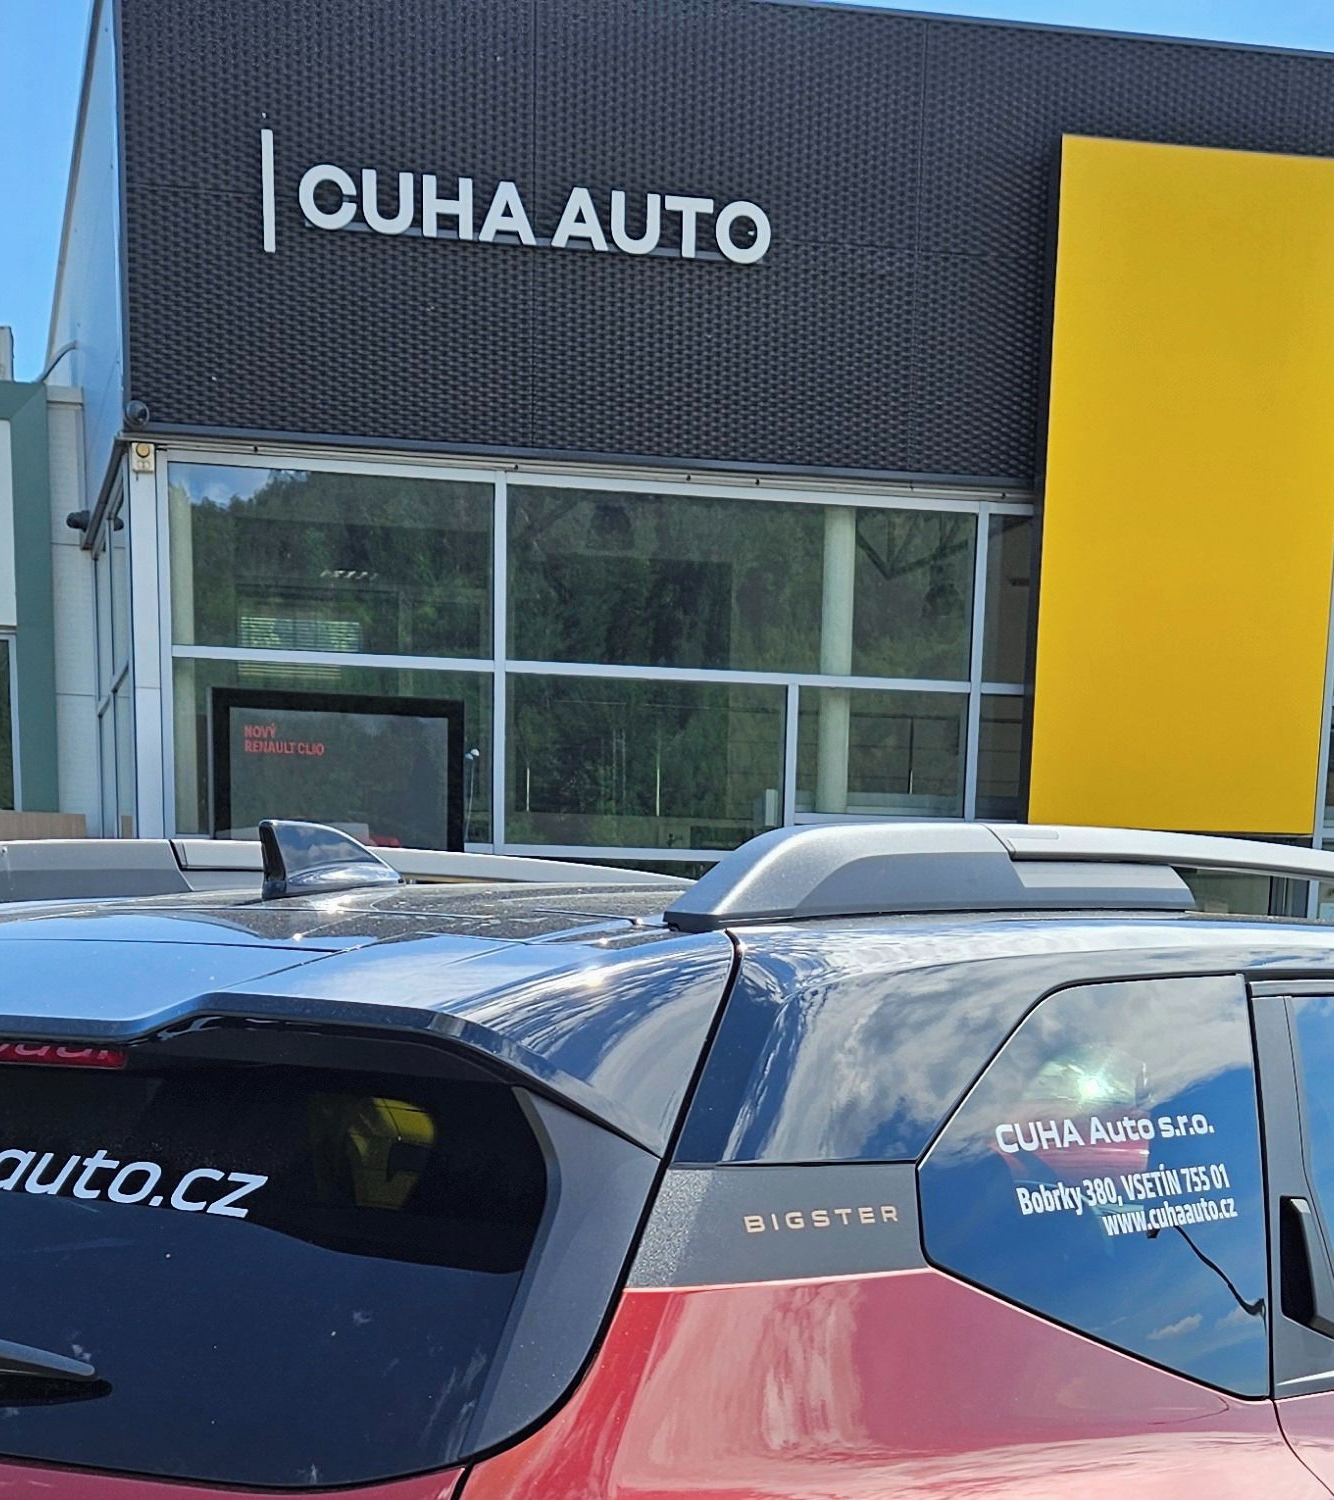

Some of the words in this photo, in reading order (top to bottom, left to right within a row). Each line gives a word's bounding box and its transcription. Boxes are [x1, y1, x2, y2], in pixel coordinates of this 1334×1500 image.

[298, 164, 536, 246] CUHA
[551, 186, 771, 264] AUTO
[244, 723, 277, 738] NOVÝ
[244, 739, 297, 755] RENAULT
[298, 742, 325, 756] CLIO
[995, 1118, 1085, 1153] CUHA
[1089, 1116, 1155, 1145] Auto
[1157, 1113, 1215, 1139] s.r.o.
[1016, 1180, 1084, 1216] Bobrky
[1083, 1177, 1124, 1207] 380,
[1120, 1164, 1183, 1201] VSETÍN
[1181, 1166, 1211, 1193] 755
[1211, 1163, 1231, 1189] 01
[743, 1205, 898, 1233] BIGSTER
[1102, 1197, 1238, 1236] www.cuhaauto.cz
